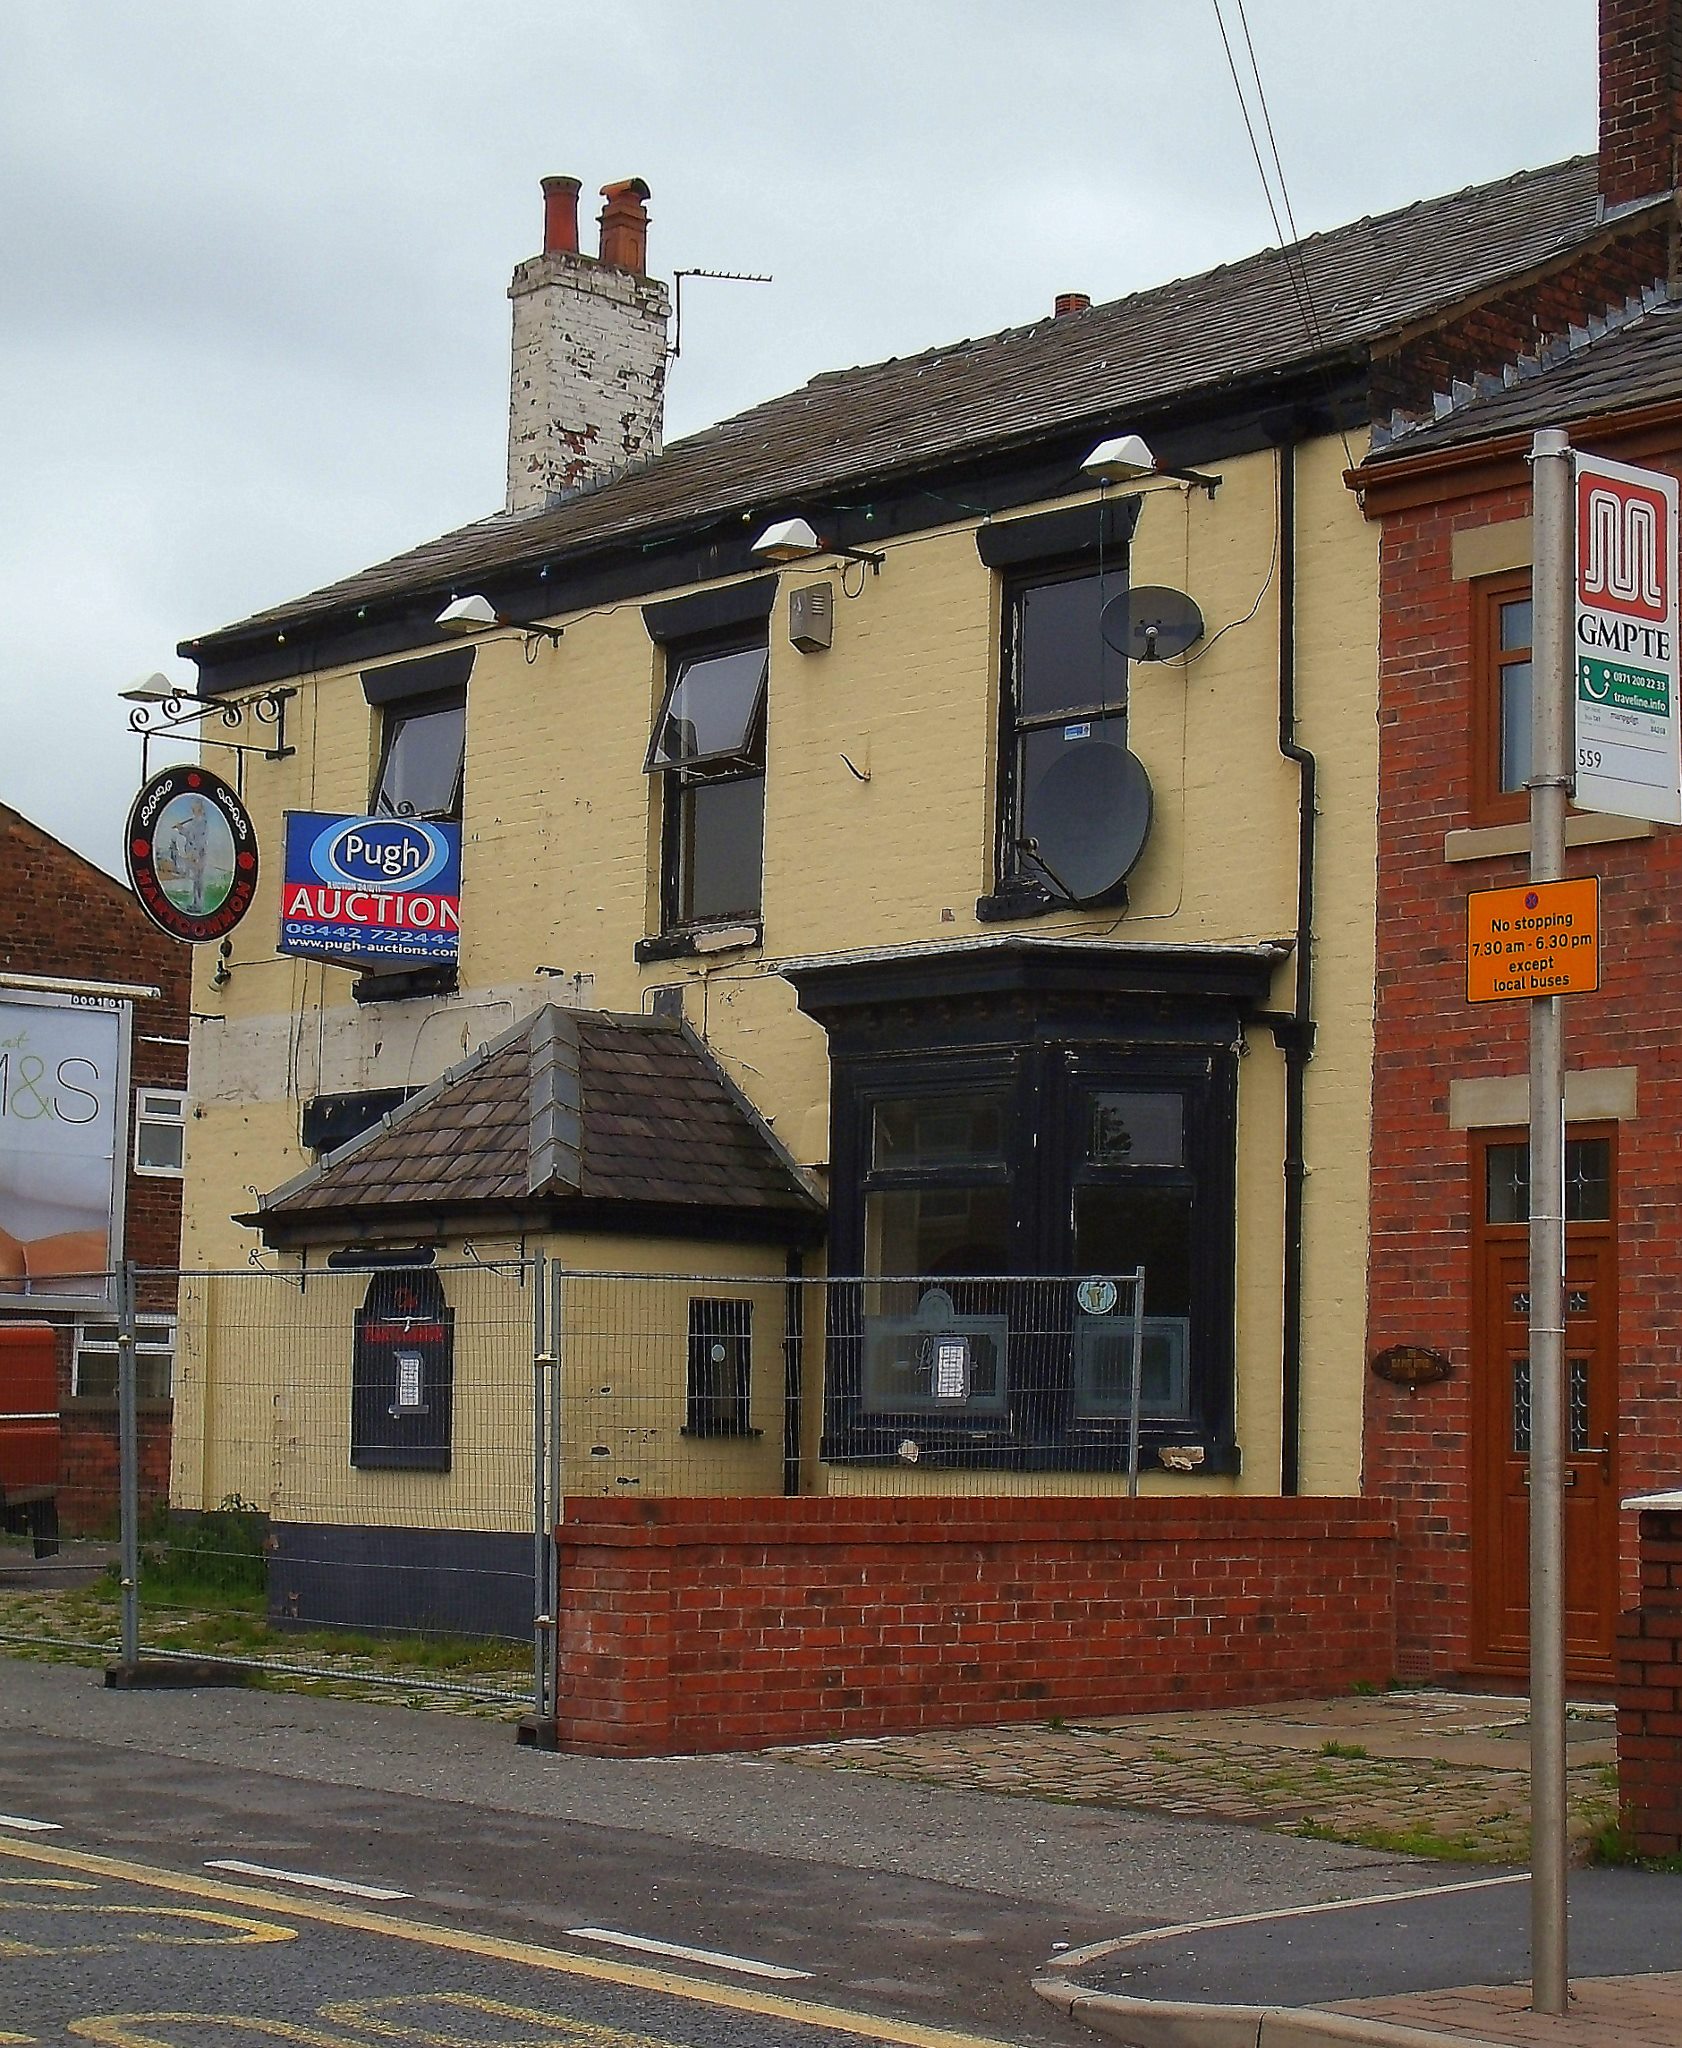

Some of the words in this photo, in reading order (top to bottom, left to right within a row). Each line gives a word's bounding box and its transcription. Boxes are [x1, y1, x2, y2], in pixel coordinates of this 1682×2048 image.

[1577, 612, 1670, 661] GMPTE
[1631, 675, 1645, 687] 200
[1646, 678, 1655, 690] 22
[1656, 680, 1666, 692] 33
[1613, 691, 1666, 712] traveline.info
[1578, 748, 1602, 768] 559
[347, 835, 420, 875] Pugh
[288, 887, 460, 928] AUCTION
[1491, 918, 1510, 933] No
[1514, 913, 1573, 931] stopping
[286, 923, 362, 939] 08442
[371, 929, 460, 946] 722444
[1472, 941, 1502, 957] 7.30
[1505, 942, 1525, 954] am
[1536, 934, 1568, 950] 6.30
[1571, 934, 1592, 949] pm
[1509, 955, 1554, 973] except
[1493, 977, 1526, 992] local
[1530, 974, 1570, 989] buses
[73, 995, 102, 1006] 0001
[109, 998, 122, 1008] 01
